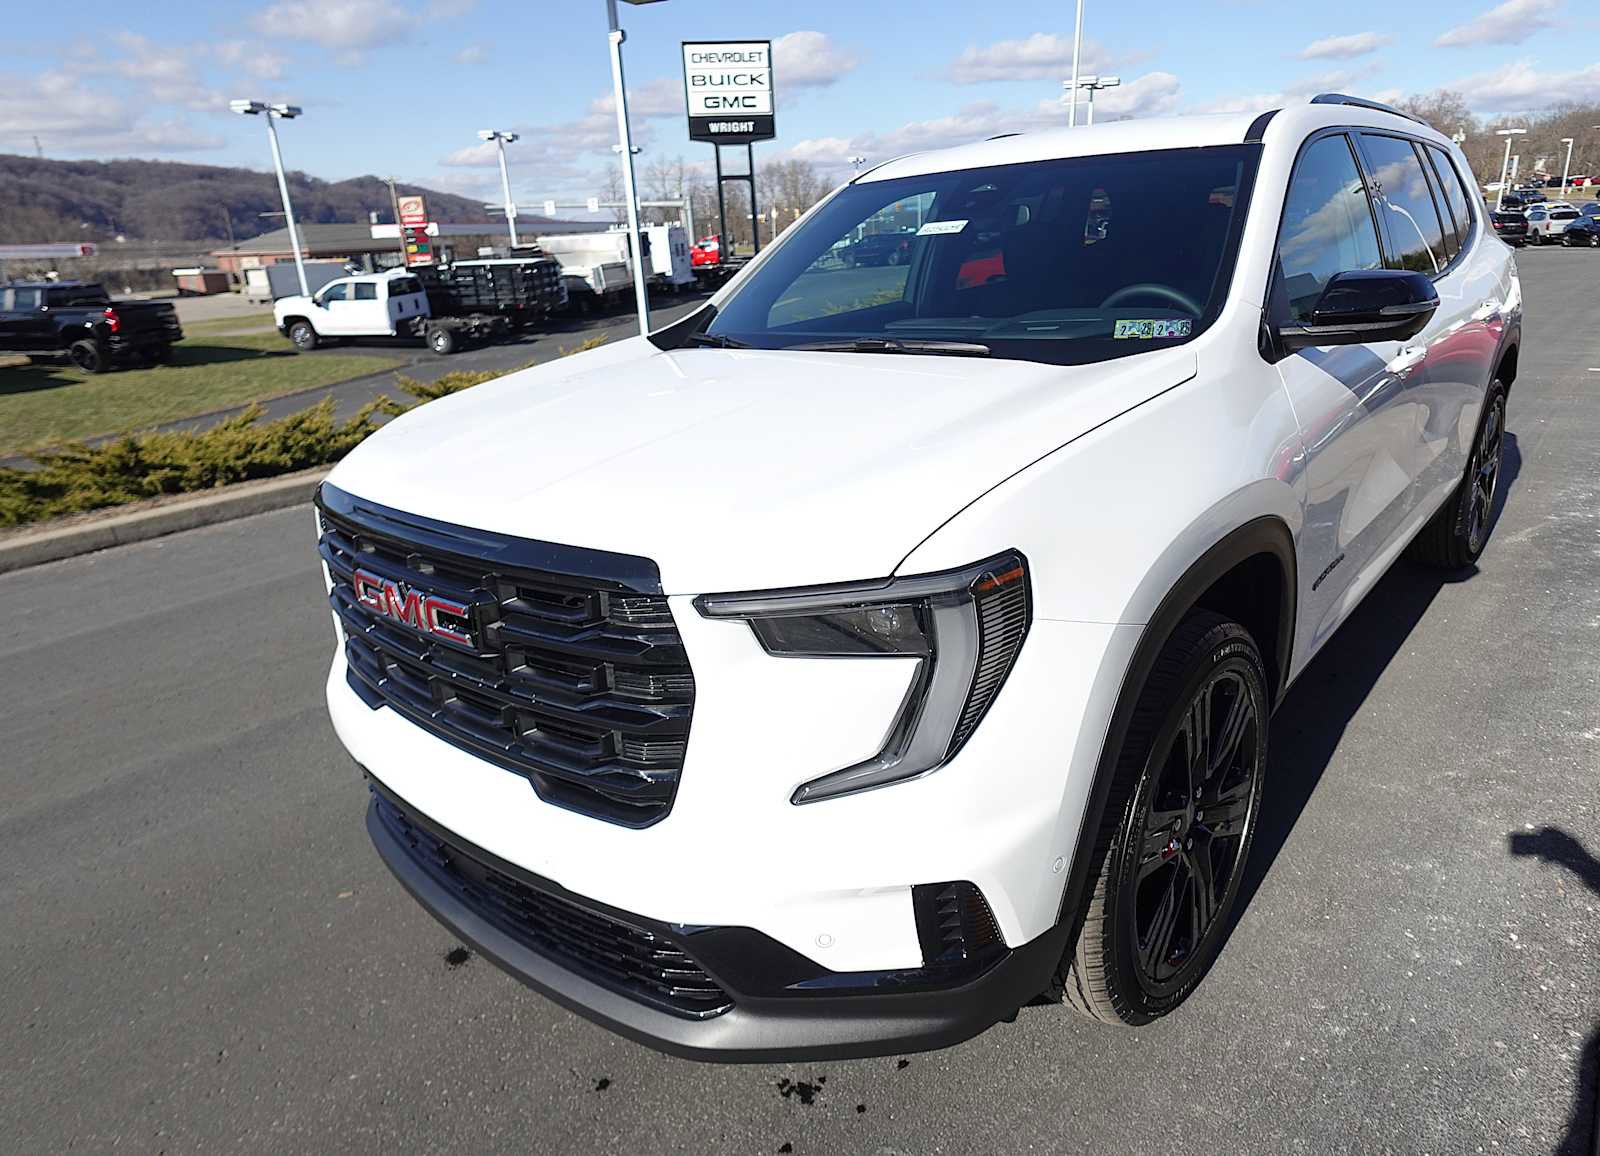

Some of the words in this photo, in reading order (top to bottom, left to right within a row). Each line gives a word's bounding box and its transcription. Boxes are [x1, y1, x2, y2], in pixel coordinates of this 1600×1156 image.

[691, 52, 763, 63] CHEVROLET
[691, 74, 764, 86] BUICK
[704, 96, 757, 108] GMC
[708, 122, 755, 133] WRIGHT
[354, 568, 474, 648] GMC
